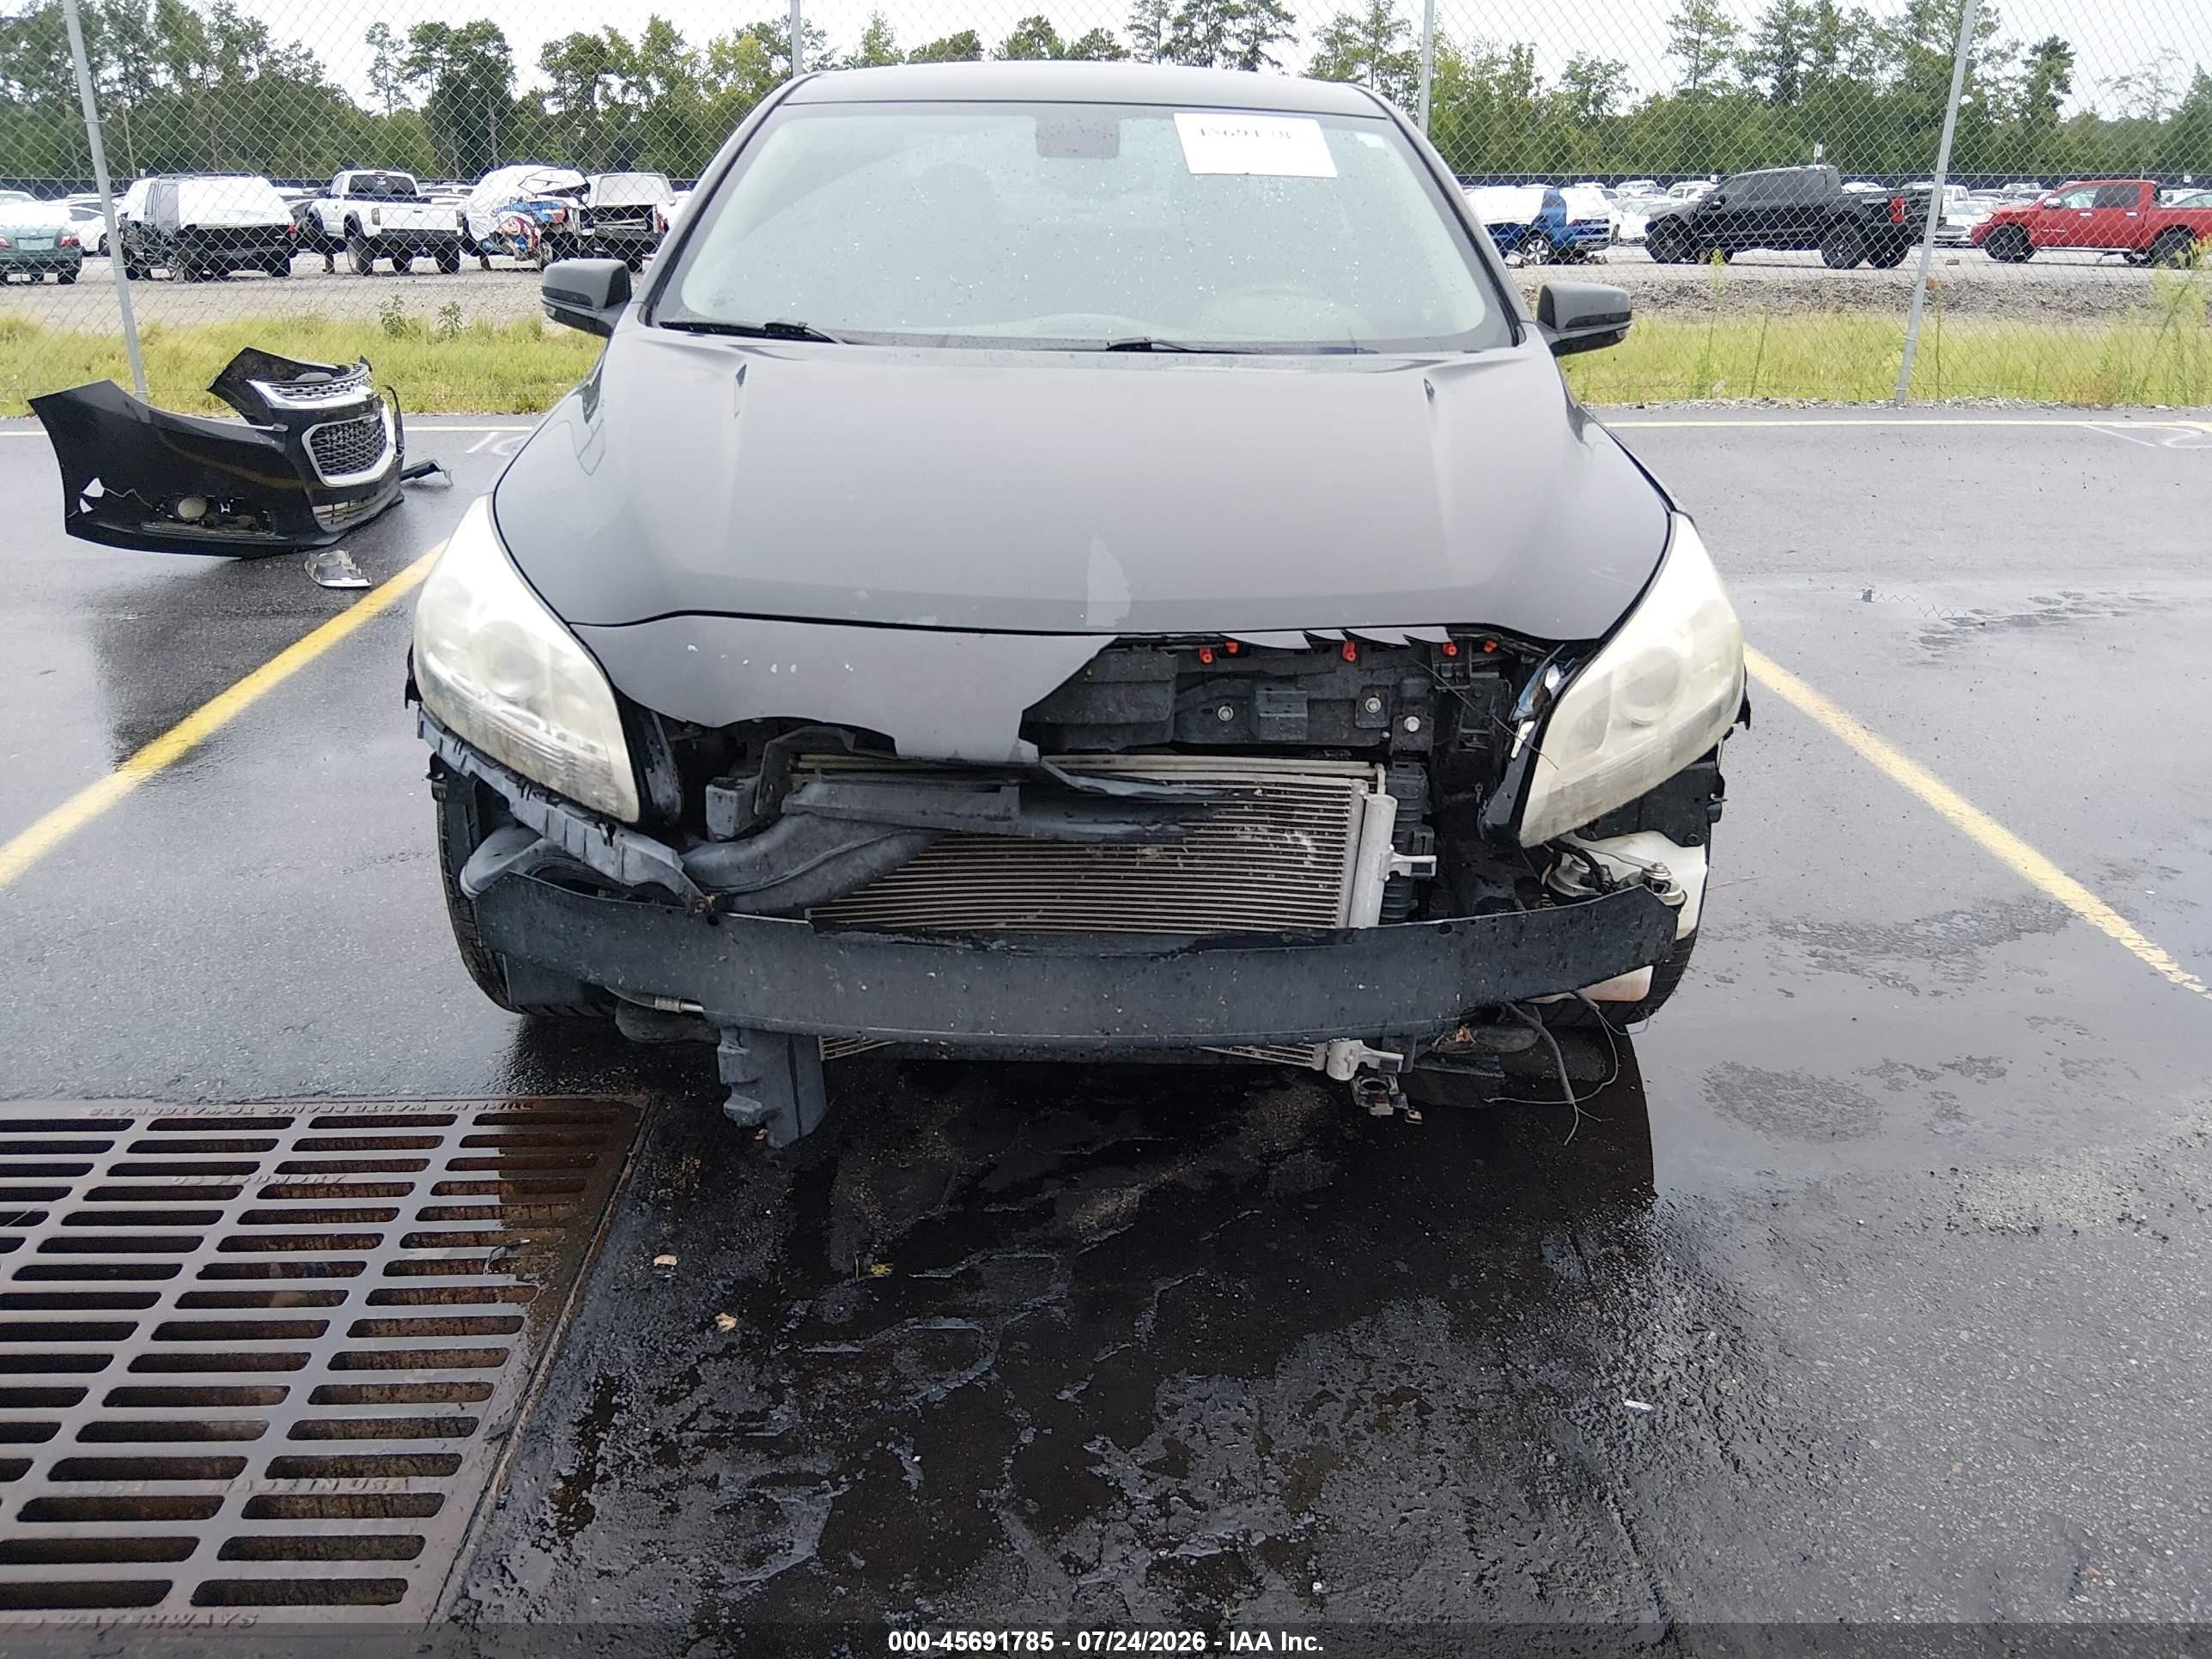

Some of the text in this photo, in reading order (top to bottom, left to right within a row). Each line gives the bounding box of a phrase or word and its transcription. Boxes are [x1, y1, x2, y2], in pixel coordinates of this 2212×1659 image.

[356, 1103, 428, 1114] WASTE
[438, 1103, 470, 1112] NO
[308, 1478, 340, 1493] IN
[349, 1478, 411, 1492] USA
